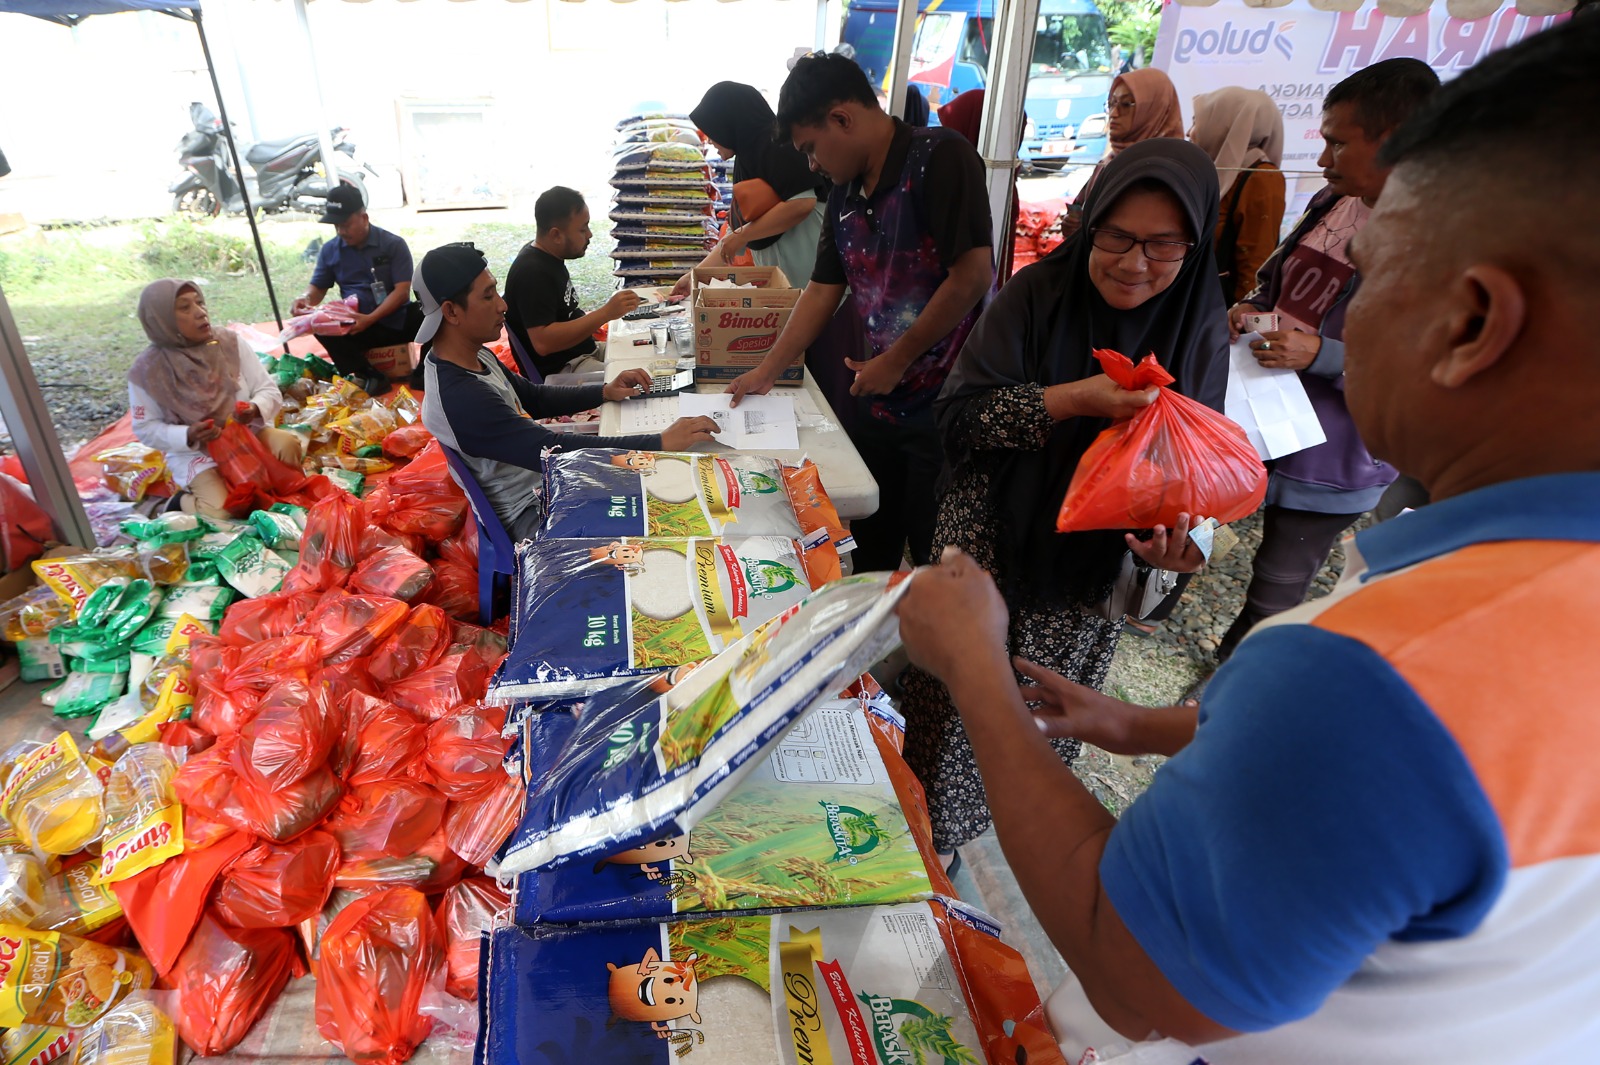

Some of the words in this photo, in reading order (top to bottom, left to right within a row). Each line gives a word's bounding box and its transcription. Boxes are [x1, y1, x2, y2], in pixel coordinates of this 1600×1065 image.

[718, 312, 780, 328] Bimoli
[365, 348, 394, 359] imoli
[737, 337, 770, 351] Spesial
[698, 458, 714, 506] Premium
[611, 495, 626, 504] 10
[608, 505, 625, 517] kg
[696, 546, 716, 616] Premium
[731, 563, 741, 585] Keluarga
[737, 587, 745, 612] Indonesia
[588, 615, 606, 628] 10
[583, 630, 606, 647] kg
[849, 724, 860, 748] Memasak
[70, 866, 102, 903] Spesial
[919, 914, 927, 927] HET
[24, 951, 51, 998] Spesial
[829, 970, 848, 1003] Beras
[784, 971, 822, 1065] Prem
